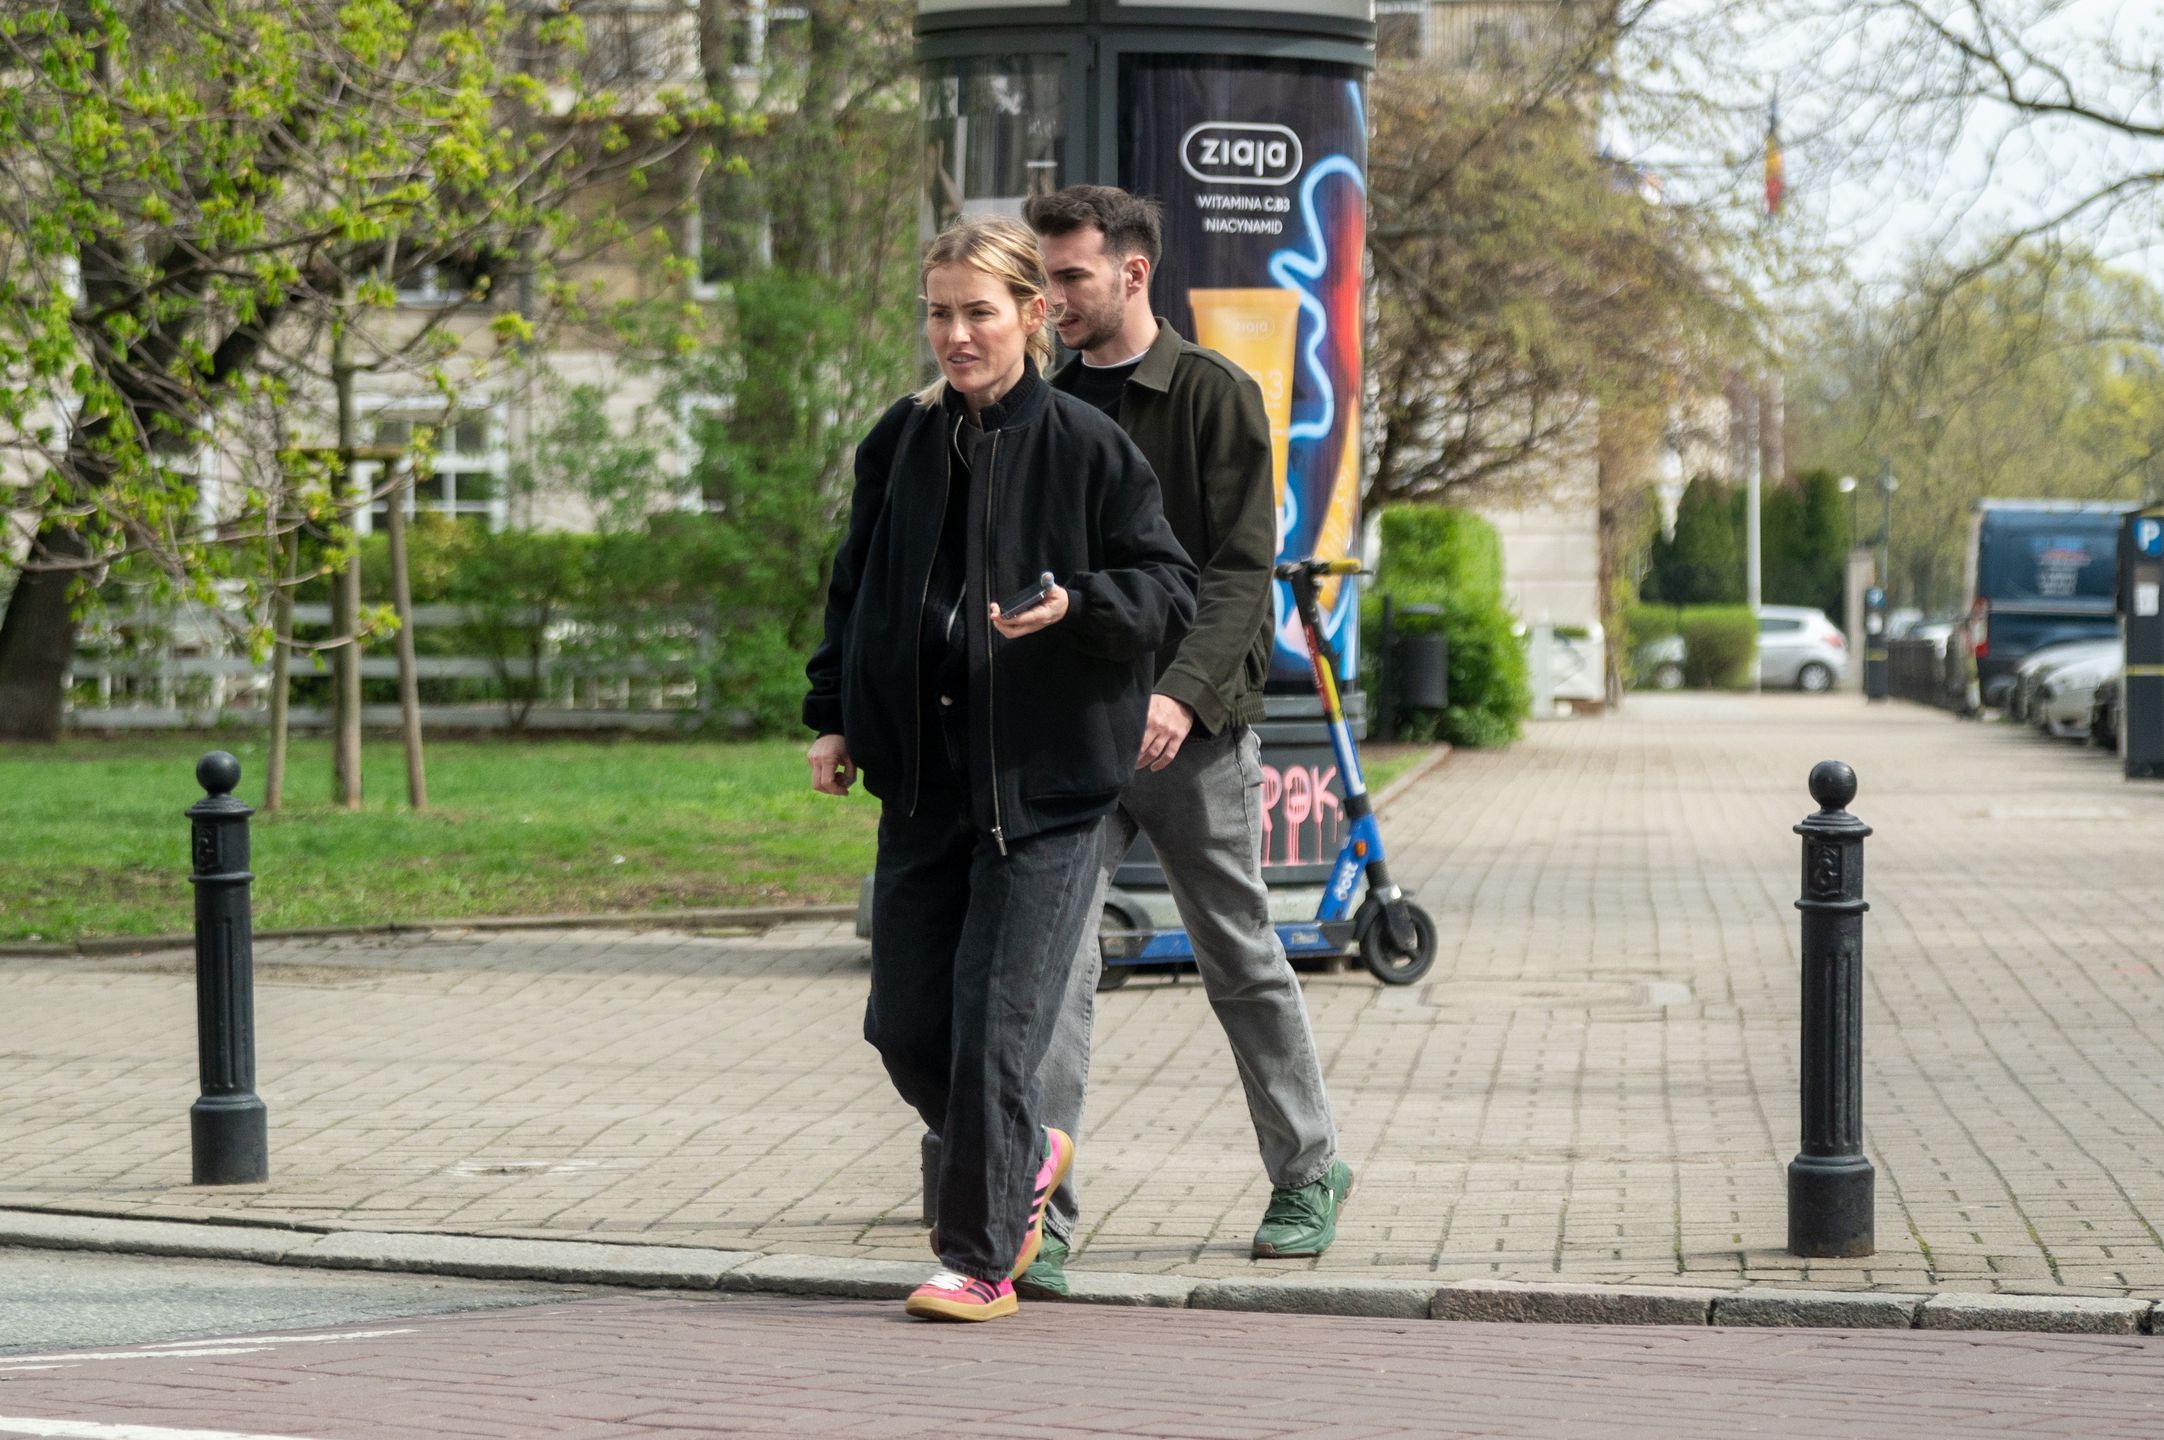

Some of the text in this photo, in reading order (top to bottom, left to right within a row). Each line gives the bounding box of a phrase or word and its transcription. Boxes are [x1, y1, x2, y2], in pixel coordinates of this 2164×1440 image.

[1200, 138, 1287, 177] ziaja
[1196, 193, 1262, 211] WITAMINA
[1202, 216, 1283, 235] NIACYNAMID
[2138, 519, 2161, 551] P
